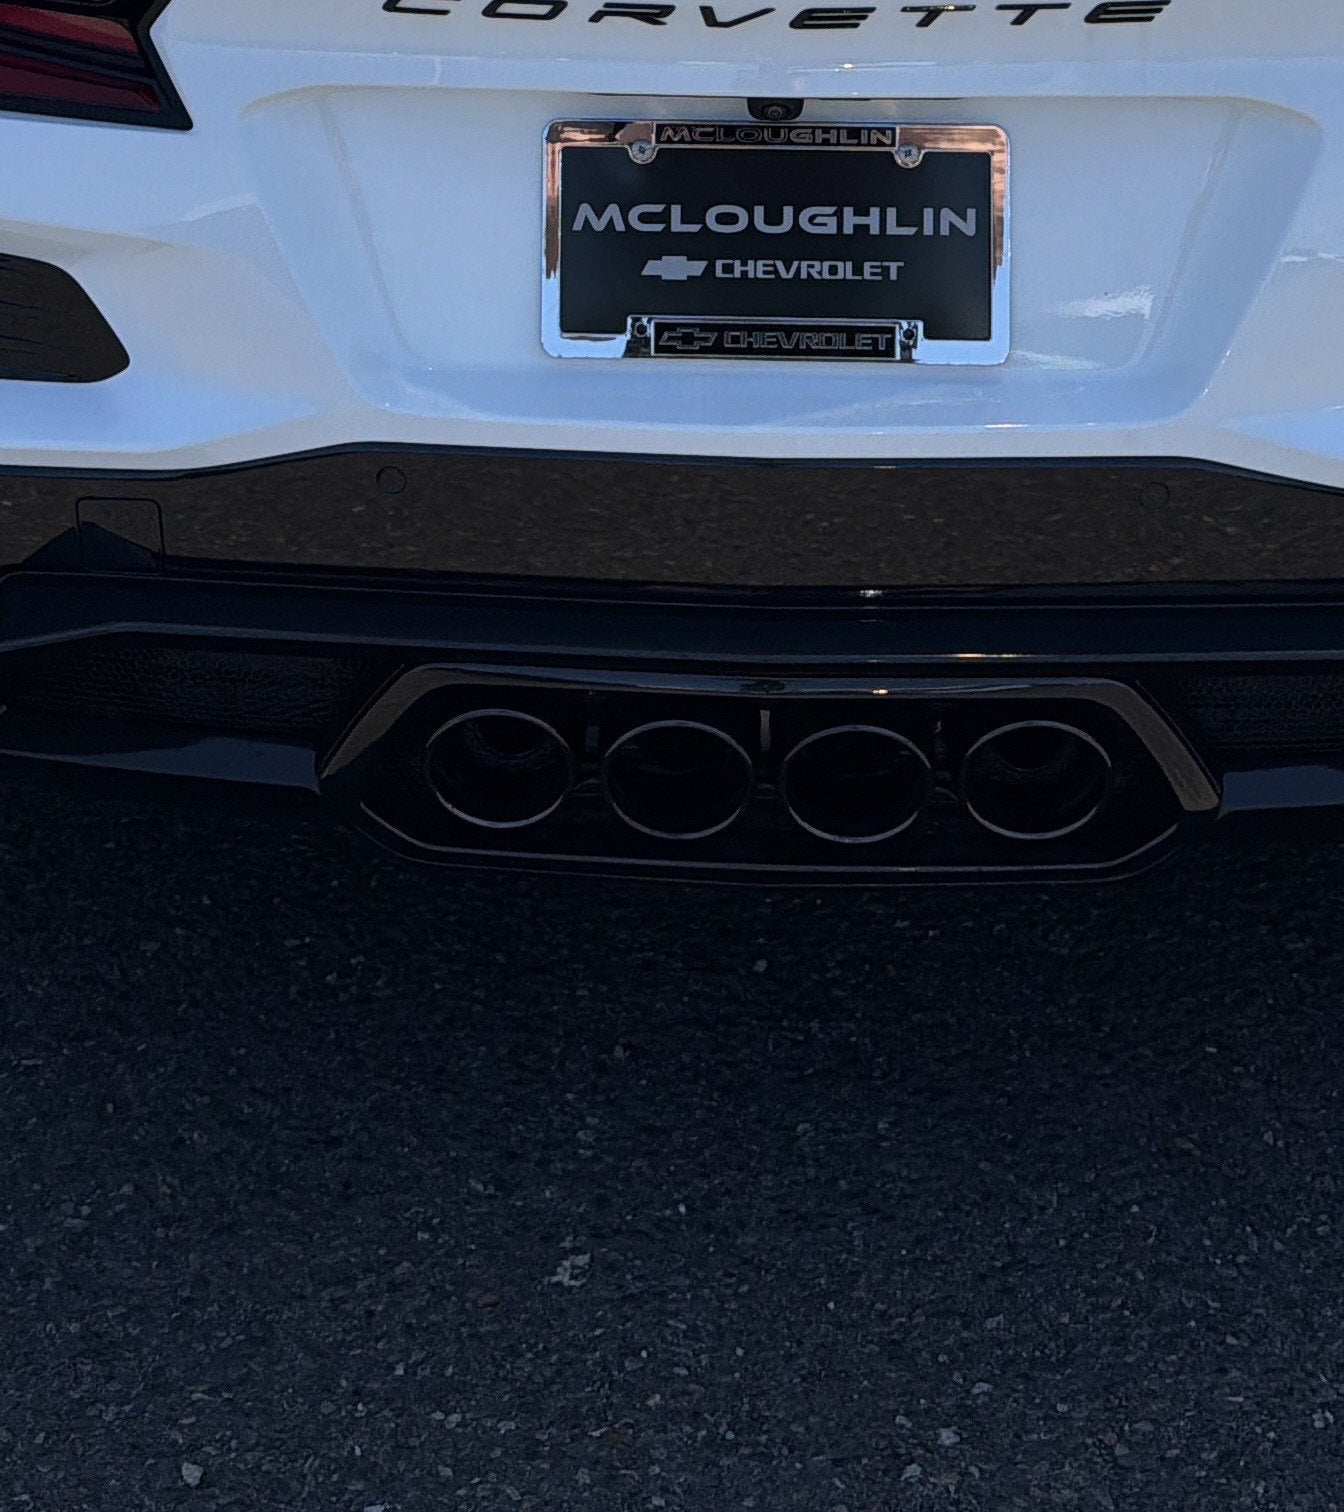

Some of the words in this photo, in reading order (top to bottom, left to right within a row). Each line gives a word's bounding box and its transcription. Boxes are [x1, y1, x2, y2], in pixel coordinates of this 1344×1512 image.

[659, 125, 893, 146] MCLOUGHLIN
[571, 202, 977, 237] MCLOUGHLIN
[714, 259, 905, 281] CHEVROLET
[723, 331, 892, 351] CHEVROLET
